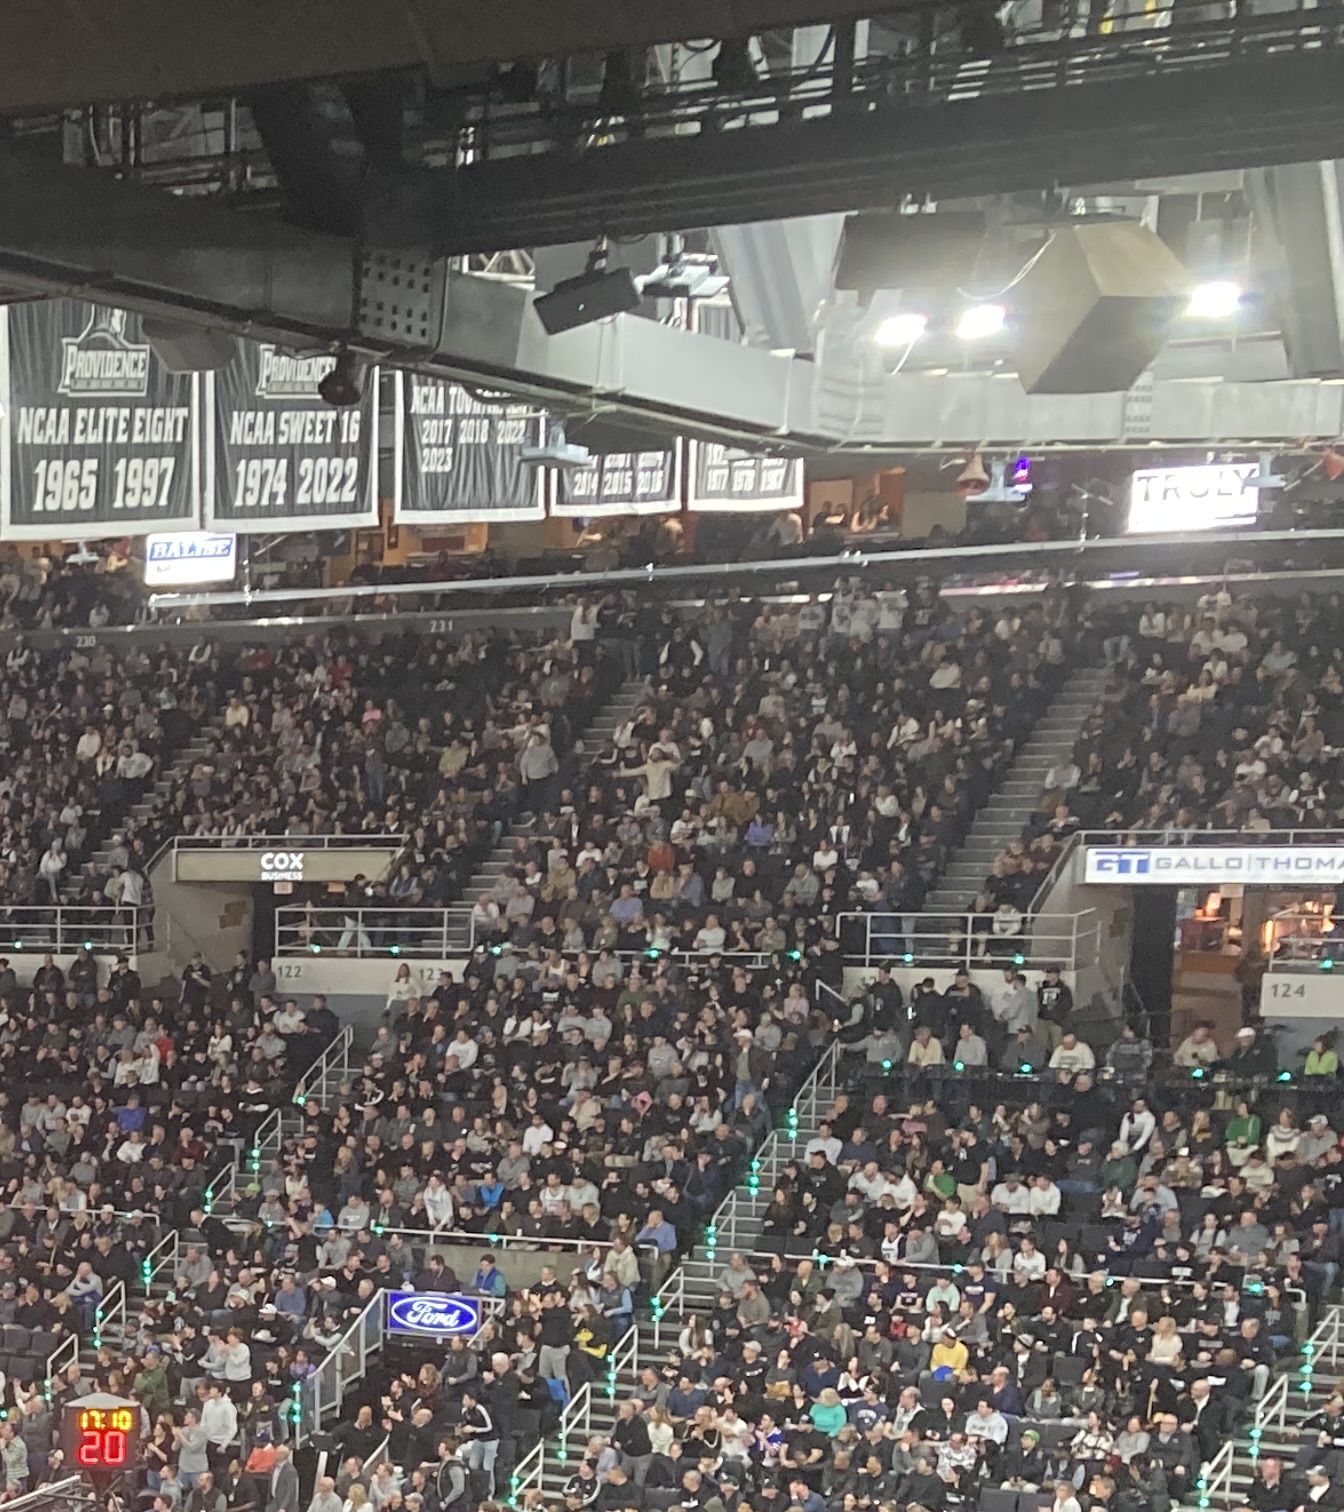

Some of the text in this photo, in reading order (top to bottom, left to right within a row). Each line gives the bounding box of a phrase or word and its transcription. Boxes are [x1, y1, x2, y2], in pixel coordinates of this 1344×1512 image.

[64, 345, 147, 385] PROVIDENCE
[411, 386, 444, 414] NCAA
[17, 407, 189, 444] NCAA ELITE EIGHT
[230, 410, 361, 445] NCAA SWEET 16
[422, 419, 526, 444] 2017 2018 2022
[422, 447, 453, 472] 2023
[33, 457, 175, 511] 1965 1997
[234, 457, 358, 507] 1974 2022
[604, 470, 632, 495] 2015
[1137, 469, 1257, 501] TRULY
[430, 620, 454, 632] 231
[76, 635, 97, 648] 230
[261, 852, 304, 870] COX
[1155, 857, 1242, 870] GALLO
[1256, 856, 1344, 871] THOMA
[277, 965, 302, 979] 122
[1271, 984, 1305, 997] 124
[407, 1301, 460, 1327] Ford
[80, 1410, 132, 1431] 17:10
[80, 1431, 126, 1464] 20
